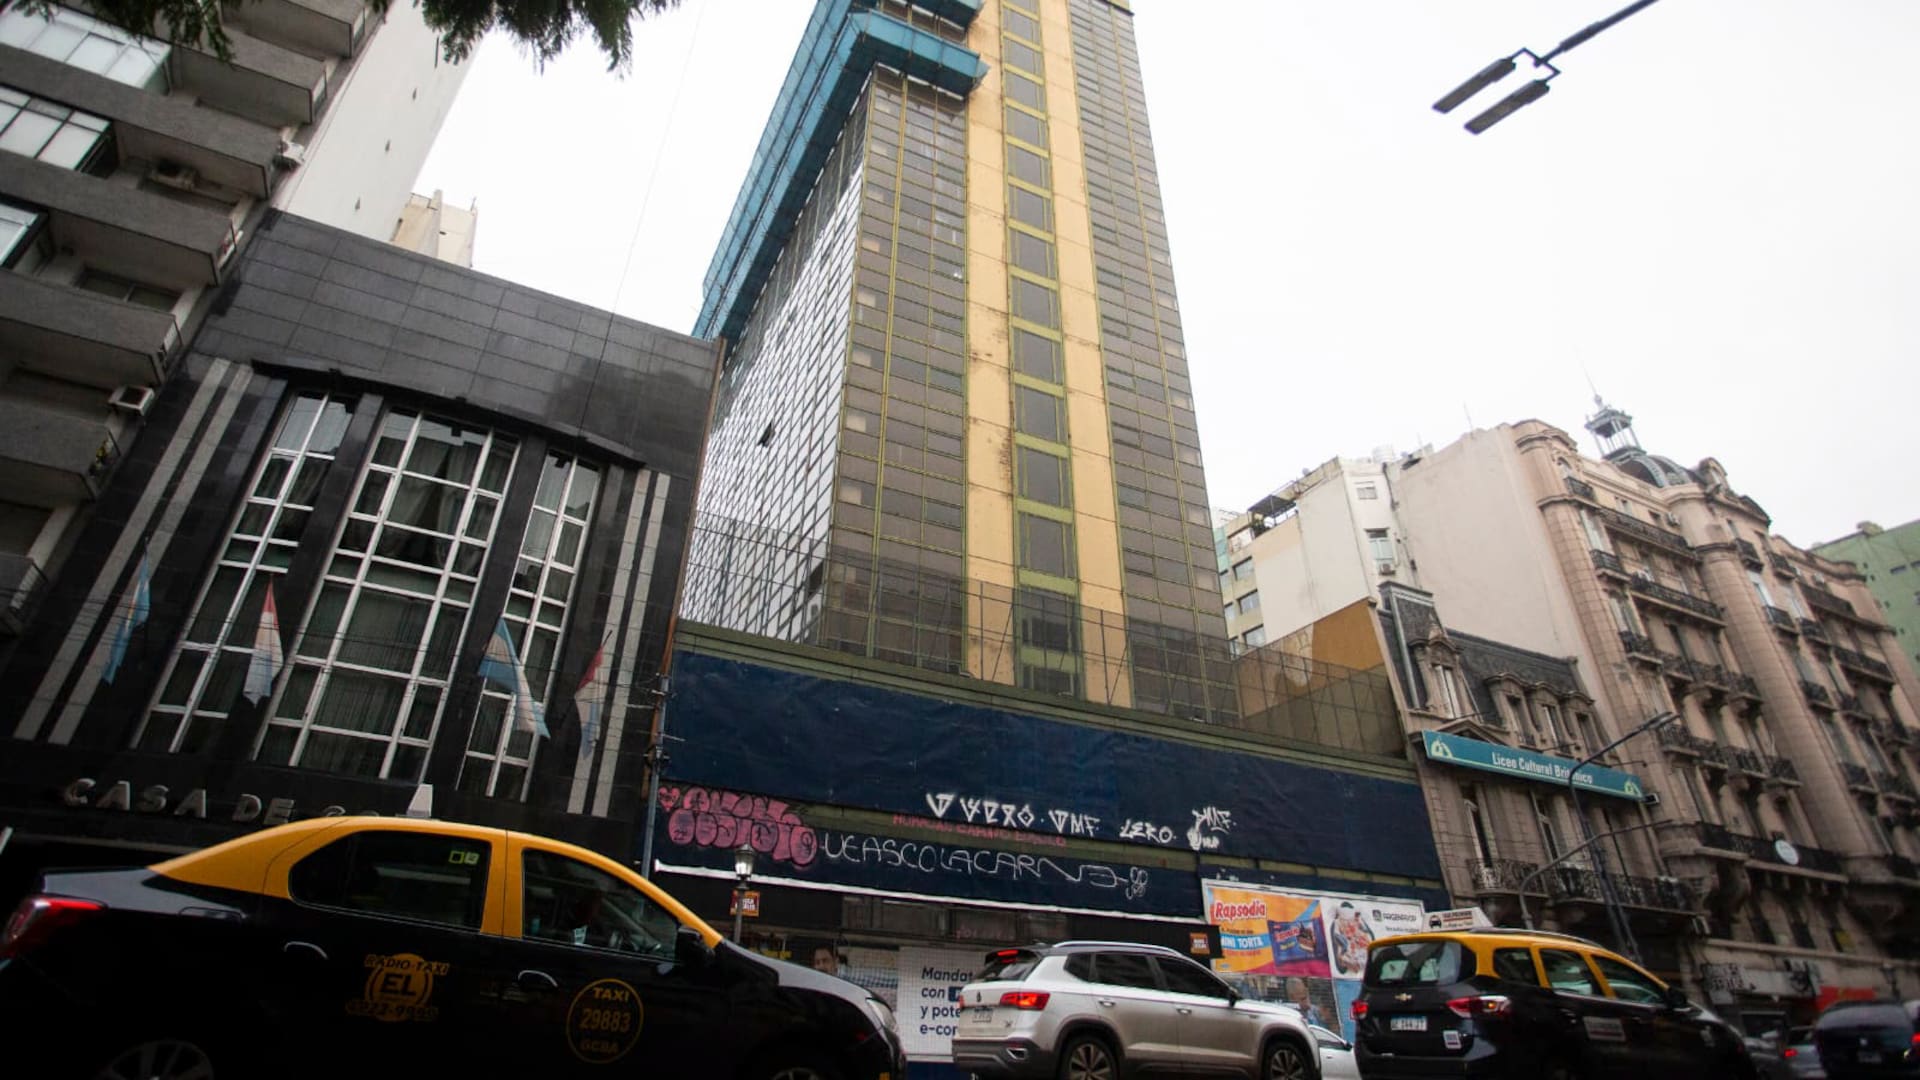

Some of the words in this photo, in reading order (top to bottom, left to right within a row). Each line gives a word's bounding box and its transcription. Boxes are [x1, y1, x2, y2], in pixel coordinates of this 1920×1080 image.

[1492, 752, 1517, 769] Liceo
[1519, 757, 1553, 777] Cultural
[1555, 764, 1593, 784] Britnico
[63, 777, 207, 819] CASA
[231, 793, 295, 825] DE
[1215, 899, 1266, 920] Rapsodia
[379, 971, 417, 997] EL
[593, 987, 630, 1003] TAXI
[921, 987, 945, 999] con
[579, 1007, 631, 1034] 29883
[920, 1005, 928, 1020] y
